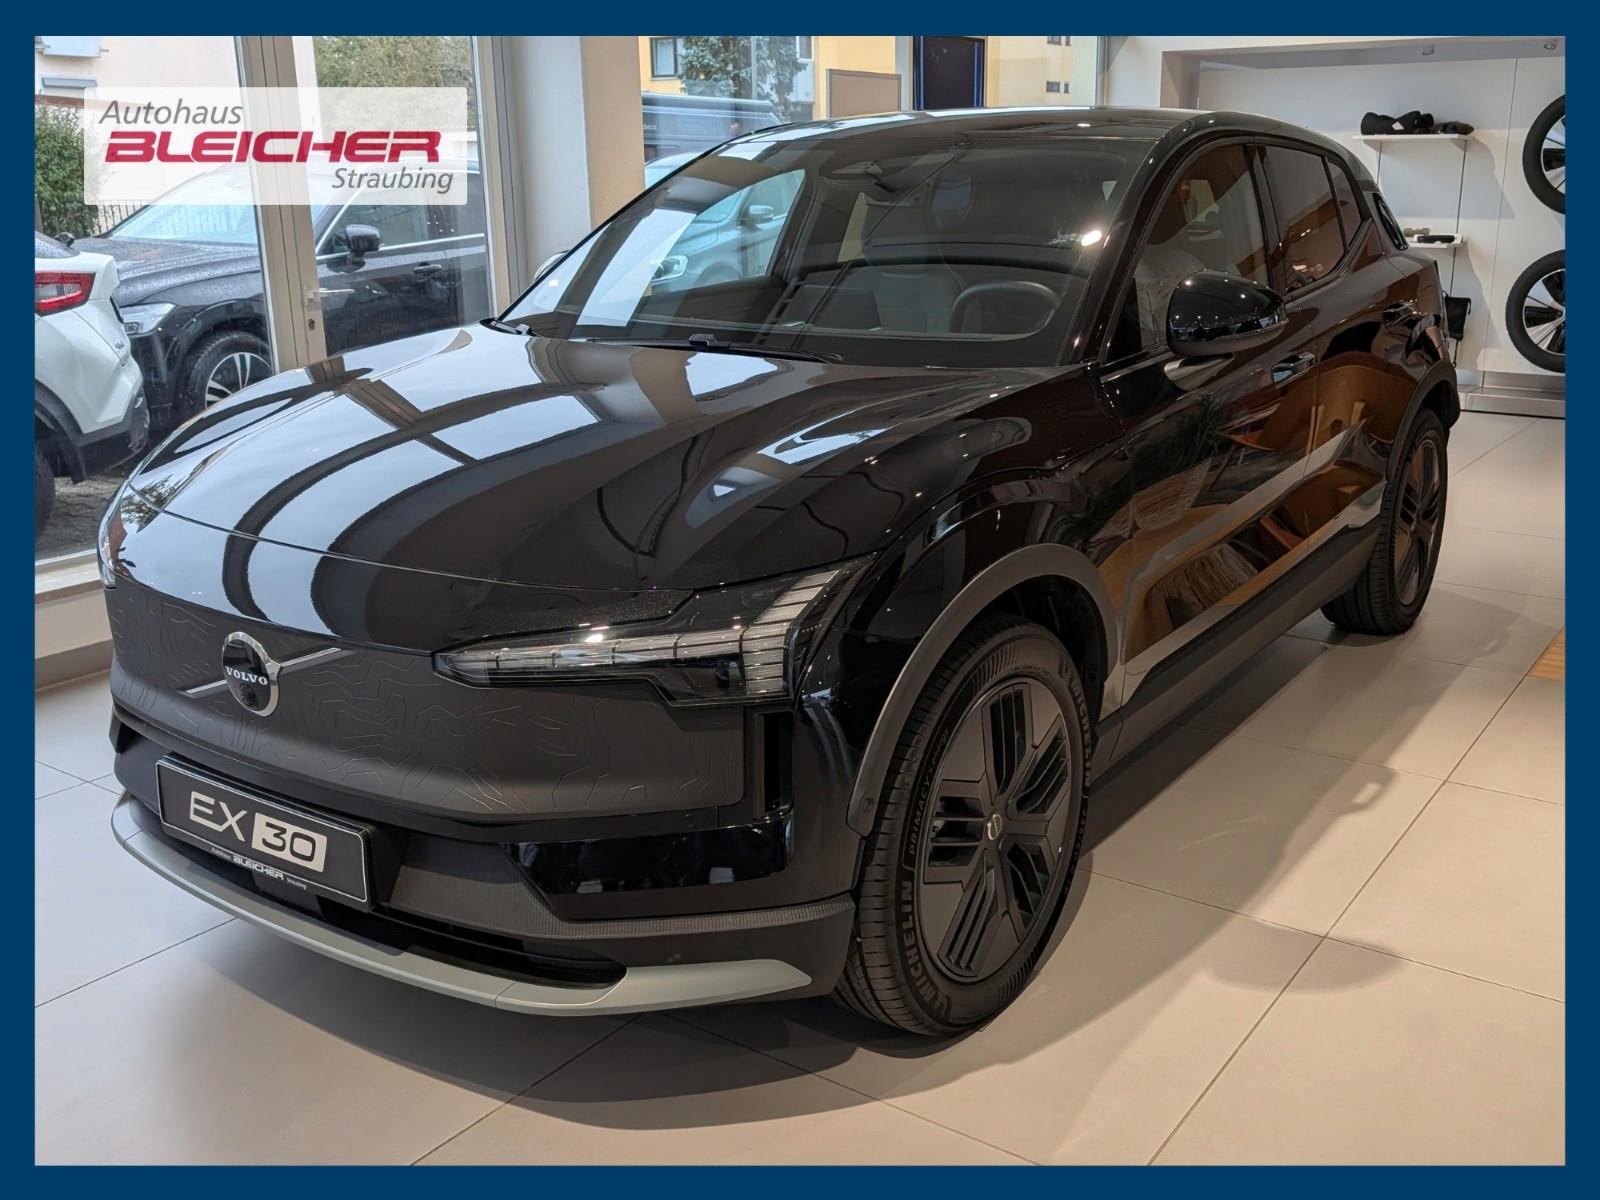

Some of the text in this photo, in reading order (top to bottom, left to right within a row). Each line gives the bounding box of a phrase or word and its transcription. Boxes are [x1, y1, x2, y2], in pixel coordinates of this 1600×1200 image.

[225, 666, 269, 686] VOLVO
[189, 790, 316, 863] EX 30
[233, 855, 285, 881] BLEICHER
[901, 880, 937, 1001] MICHELIN
